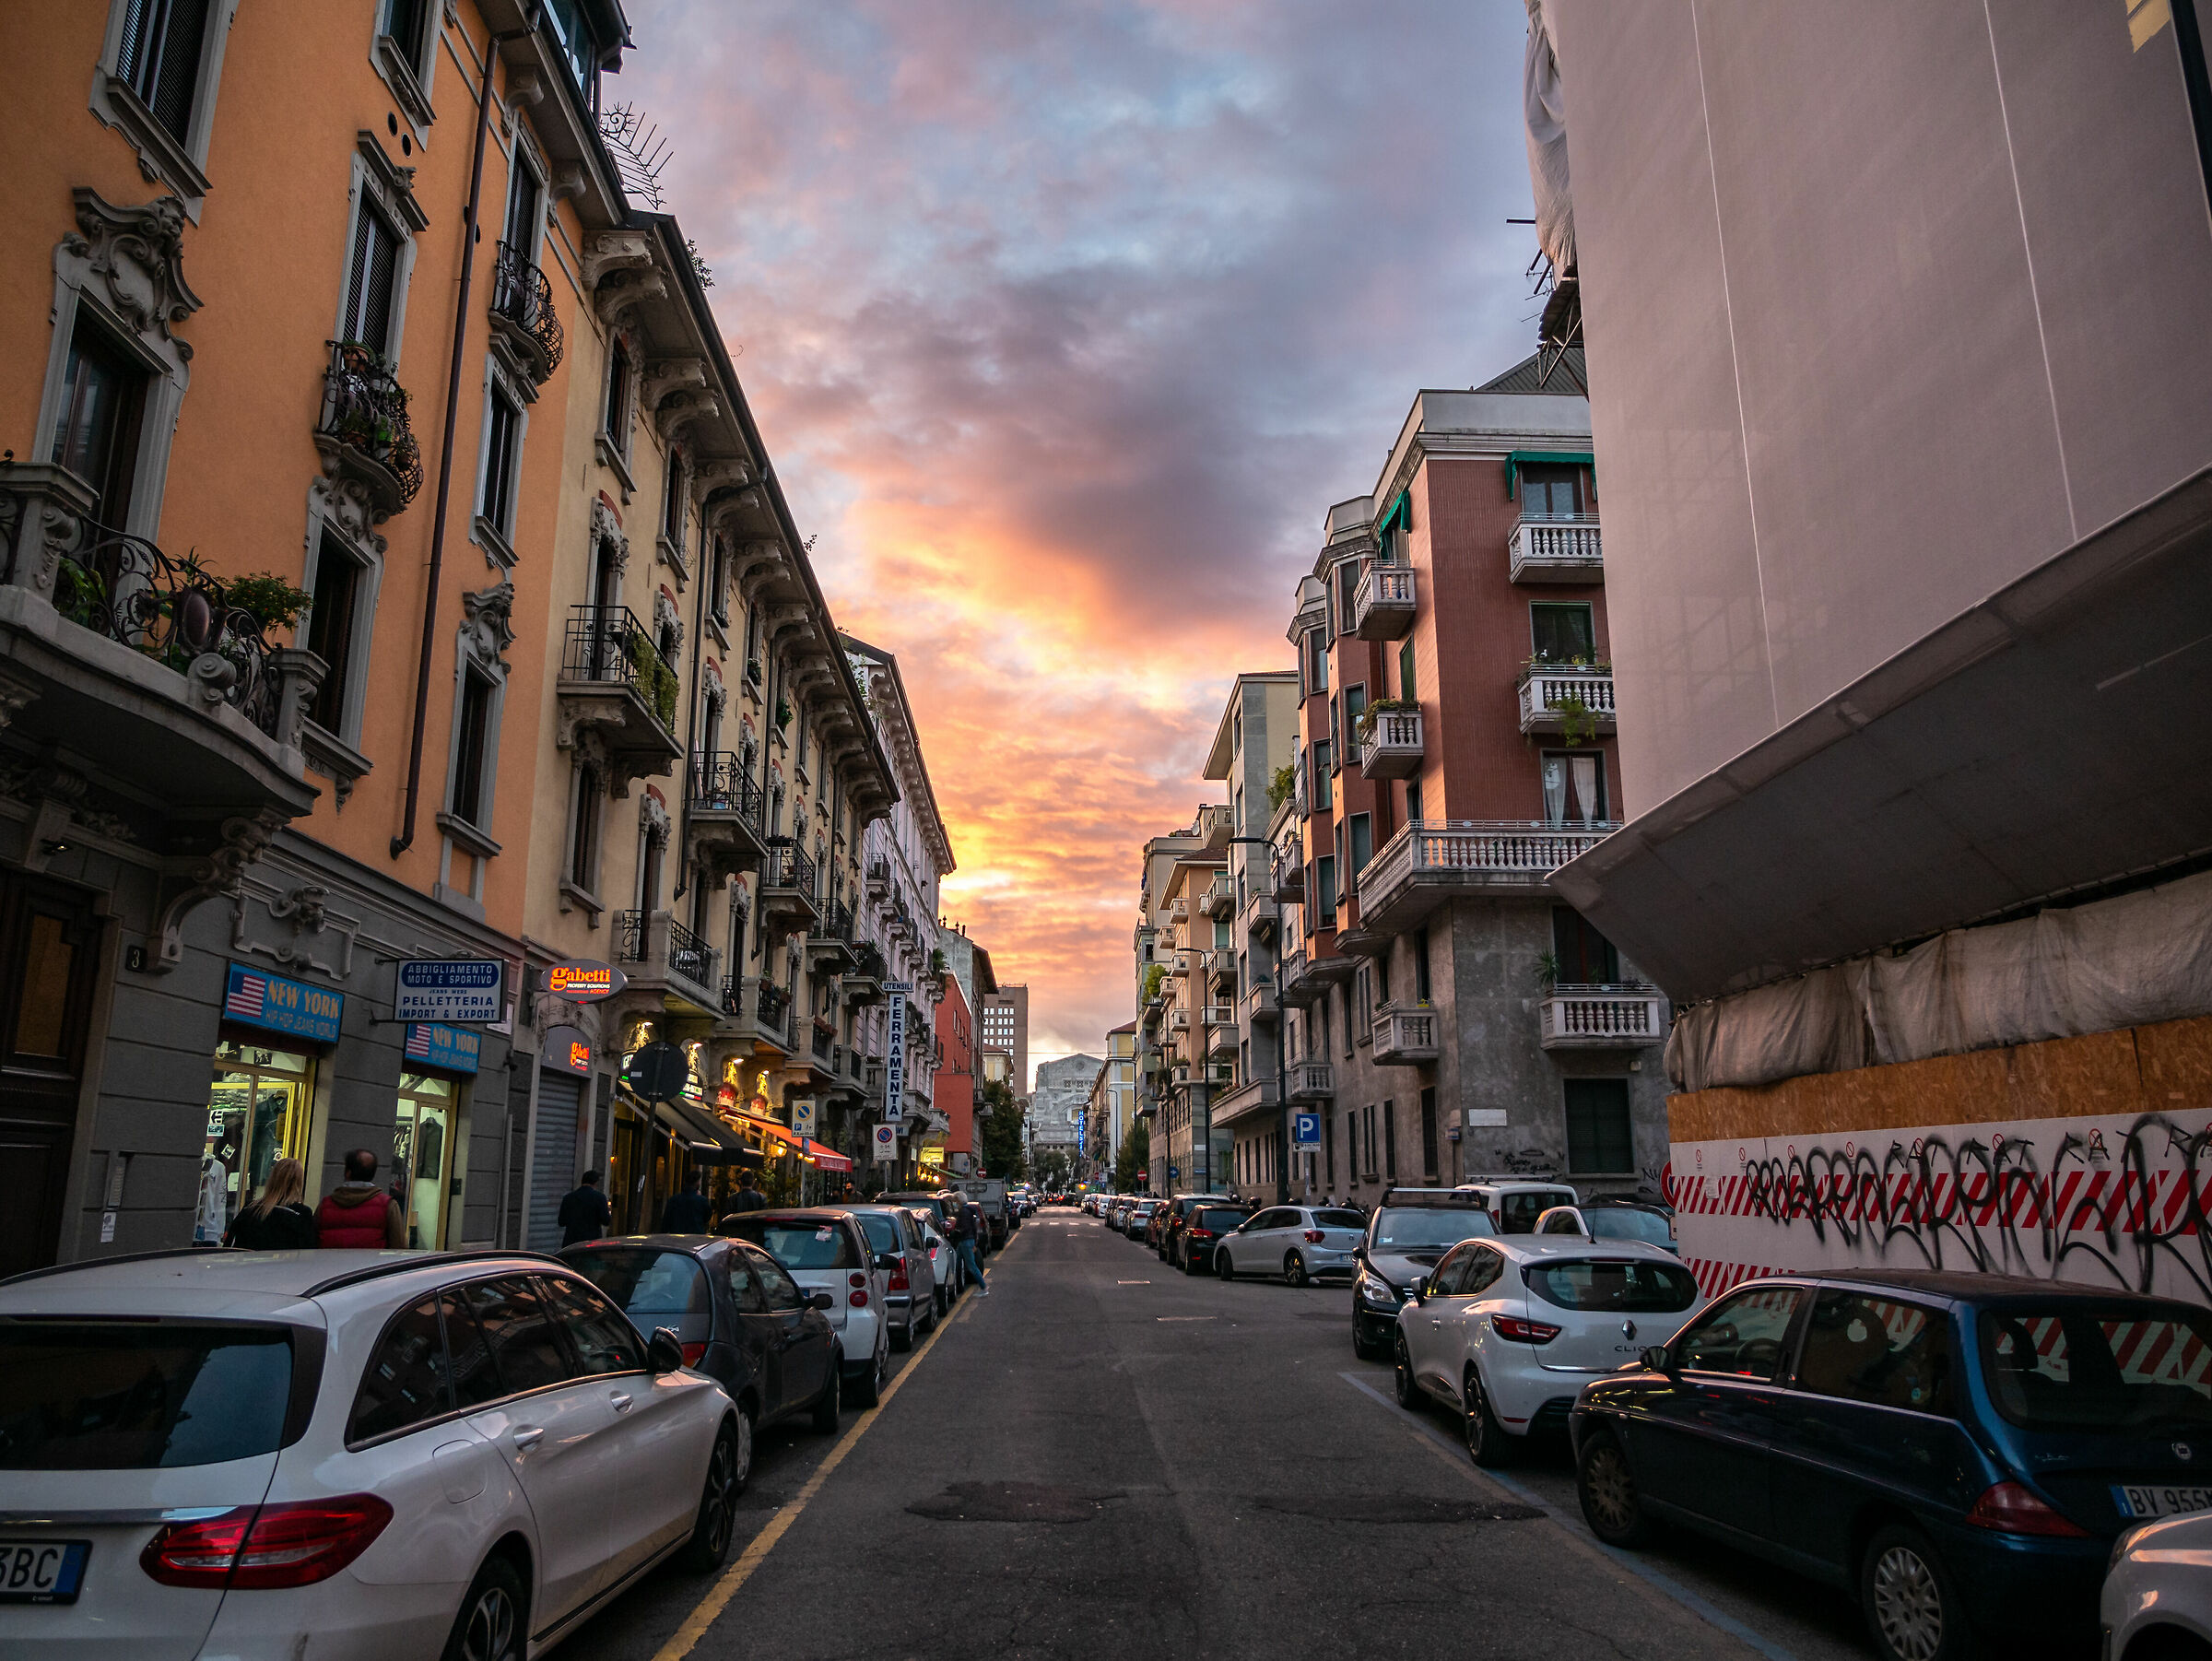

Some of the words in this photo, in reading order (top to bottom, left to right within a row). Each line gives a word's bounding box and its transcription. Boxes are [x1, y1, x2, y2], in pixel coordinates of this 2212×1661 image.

[132, 949, 140, 968] 3
[407, 965, 492, 974] ABBIGLIAMENTO
[407, 975, 431, 984] MOTO
[438, 975, 442, 984] E
[450, 975, 492, 984] SPORTIVO
[549, 967, 611, 991] gabetti
[267, 980, 300, 1008] NEW
[304, 990, 339, 1019] YORK
[403, 996, 493, 1006] PELLETTERIA
[398, 1009, 436, 1019] IMPORT
[443, 1009, 450, 1019] &
[457, 1009, 496, 1019] EXPORT
[888, 996, 902, 1116] FERRAMENTA
[1300, 1117, 1314, 1139] P
[2129, 1488, 2159, 1514] BV
